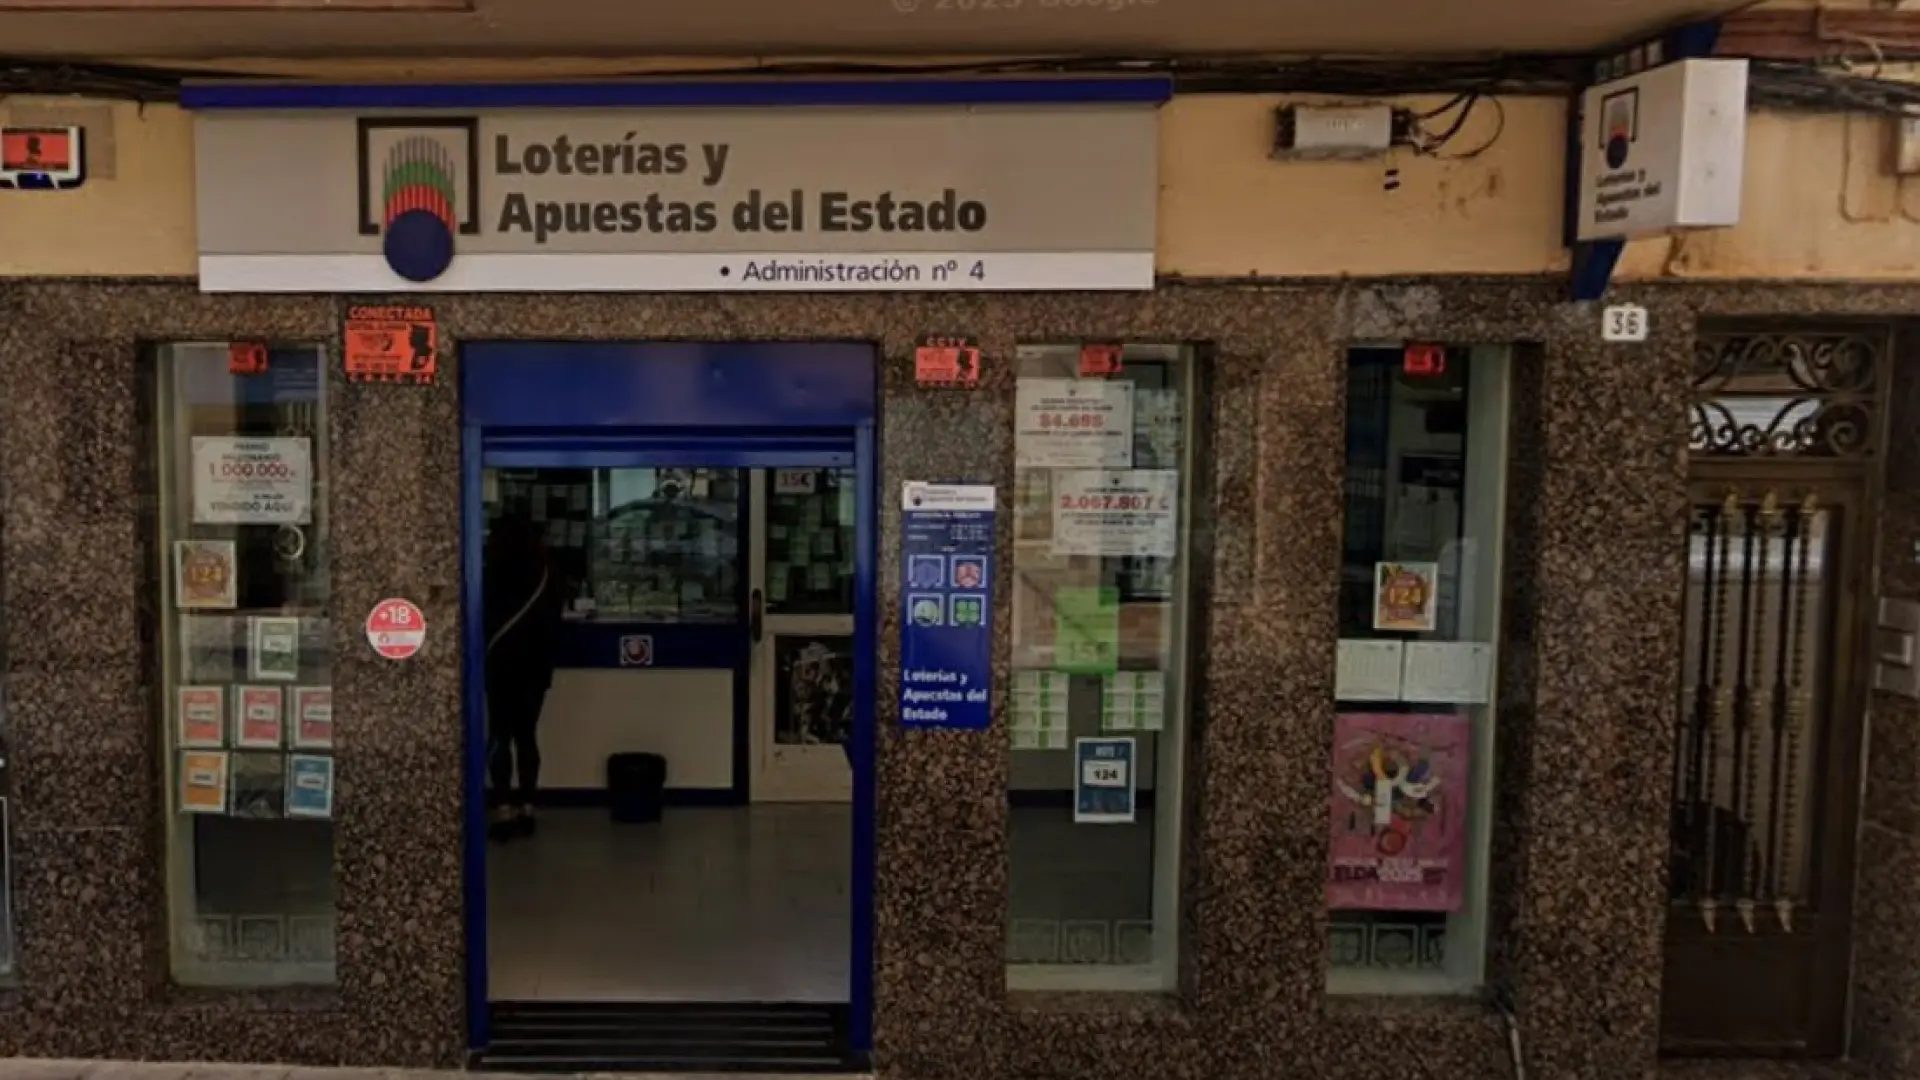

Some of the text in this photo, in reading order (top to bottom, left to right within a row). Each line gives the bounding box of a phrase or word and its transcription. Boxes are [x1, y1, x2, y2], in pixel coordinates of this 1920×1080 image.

[495, 131, 730, 187] Loterías y
[497, 188, 987, 244] Apuestas del Estado
[742, 259, 985, 282] Administración nº 4
[350, 306, 432, 320] CONECTADA
[1611, 310, 1640, 336] 36
[903, 687, 988, 704] Apuestas del
[902, 706, 949, 721] Estado
